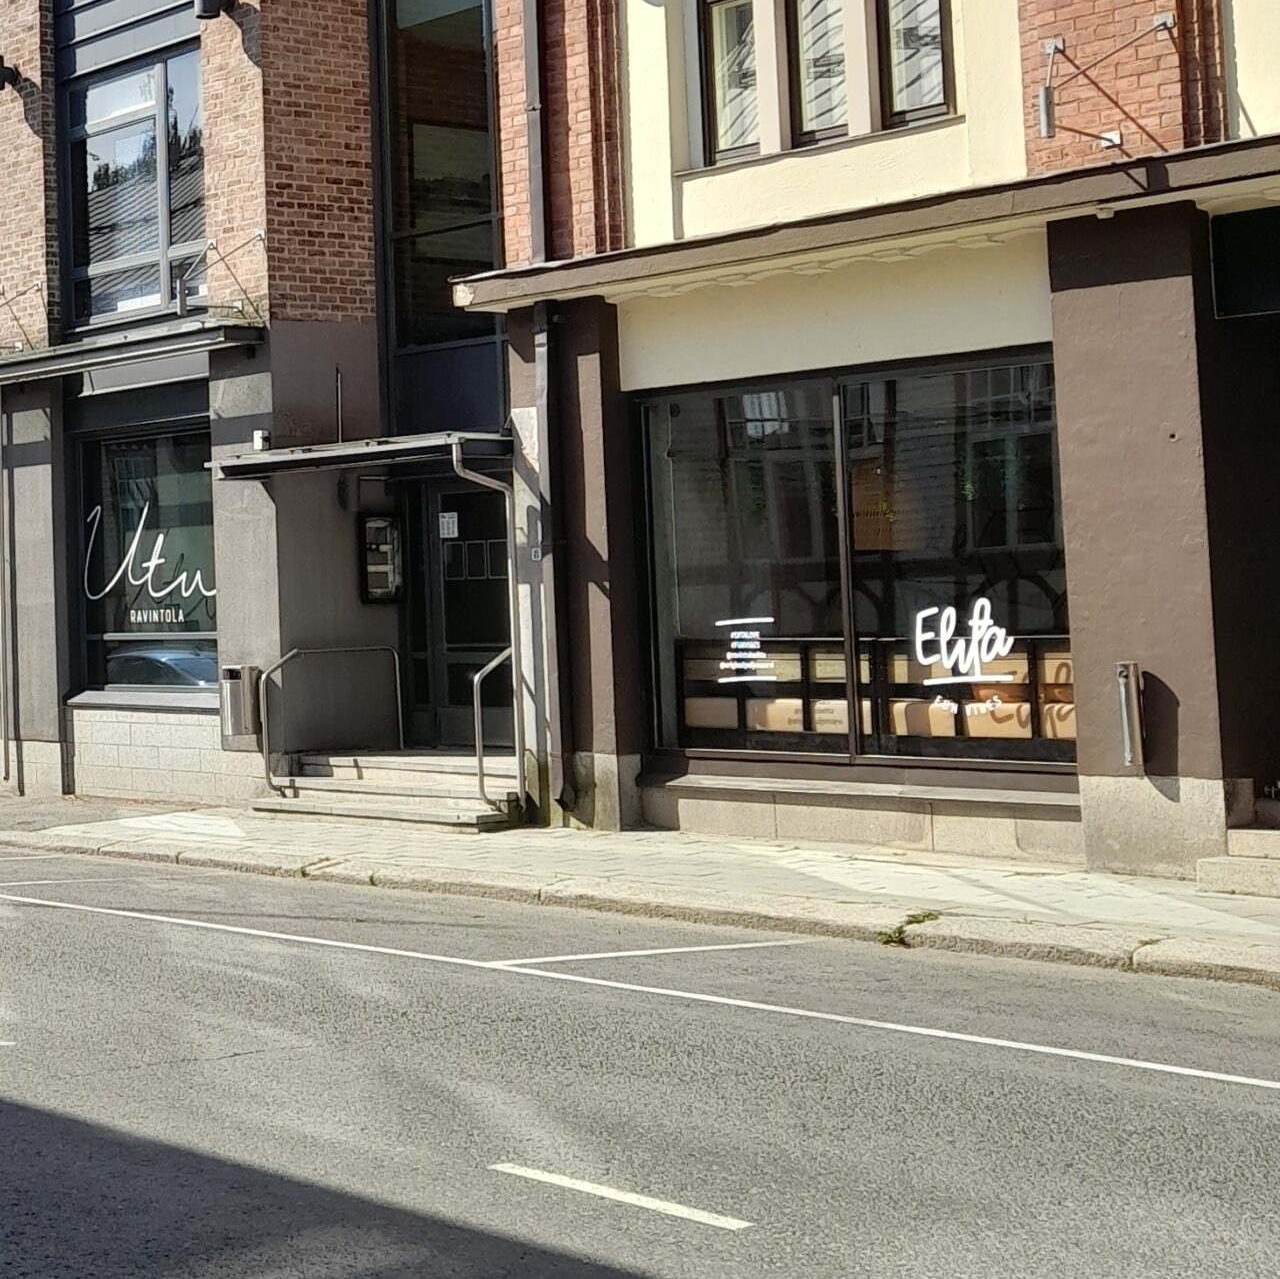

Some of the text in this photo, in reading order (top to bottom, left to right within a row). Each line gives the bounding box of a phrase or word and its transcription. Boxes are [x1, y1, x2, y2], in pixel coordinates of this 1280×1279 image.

[84, 501, 217, 600] Utu
[130, 609, 184, 623] RAVINTOLA
[934, 695, 1003, 716] FUN VIBES
